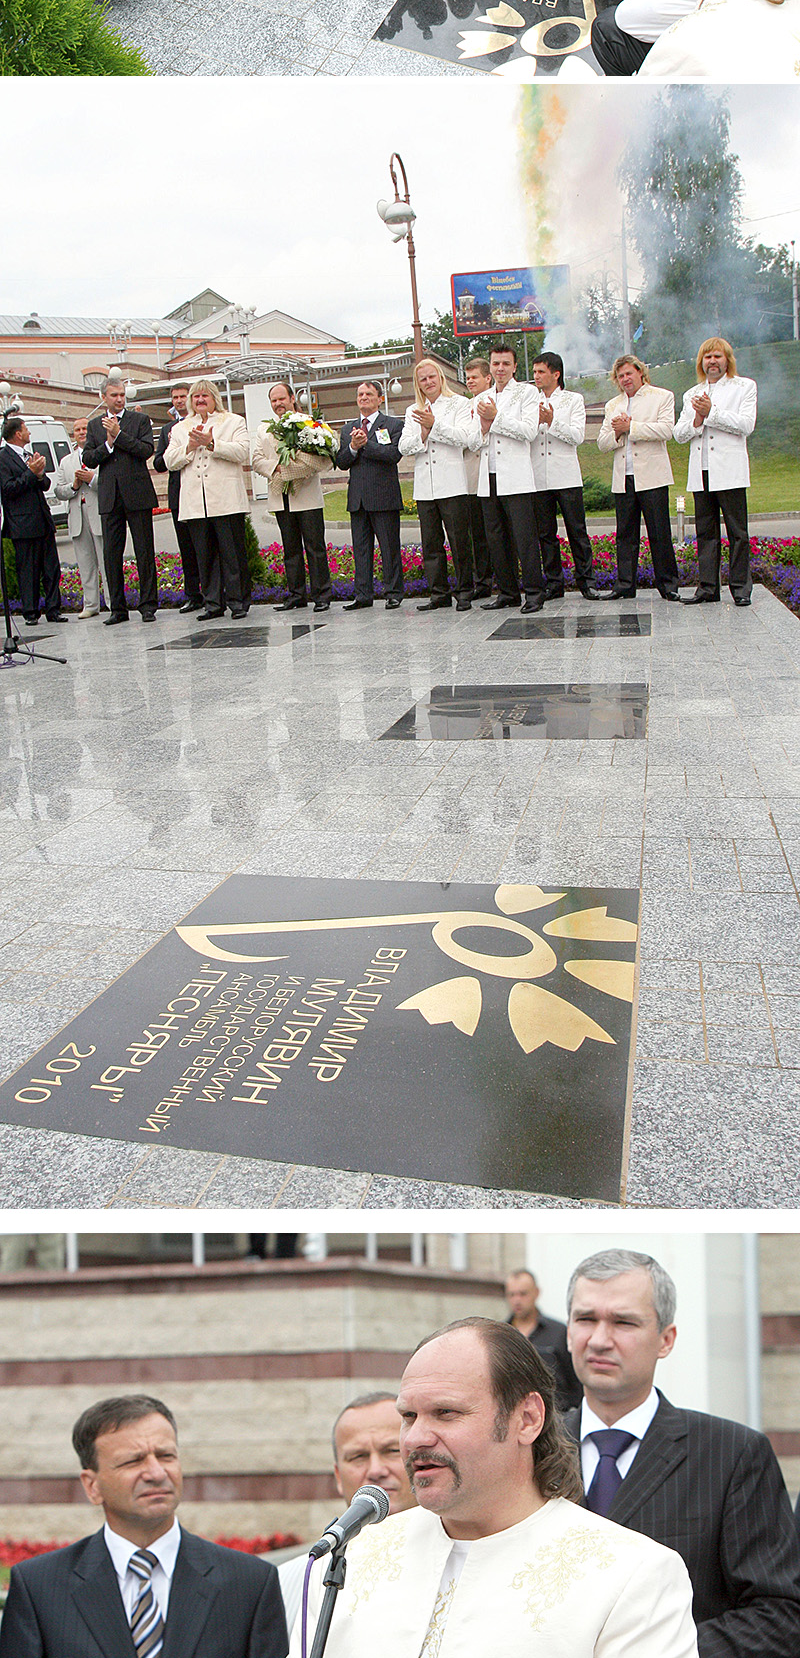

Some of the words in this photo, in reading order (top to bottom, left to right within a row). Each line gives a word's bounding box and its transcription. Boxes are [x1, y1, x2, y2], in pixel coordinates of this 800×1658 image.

[178, 972, 251, 1049] АНСАМБЛЬ
[284, 975, 306, 986] И
[307, 946, 408, 1083] ВЛАДИМИР
[14, 1042, 97, 1104] 2010
[138, 974, 271, 1133] ГОСУДАРСТВЕННЫЙ
[195, 988, 298, 1103] БЕЛОРУССКИЙ
[231, 977, 346, 1105] МУЛЯВИН
